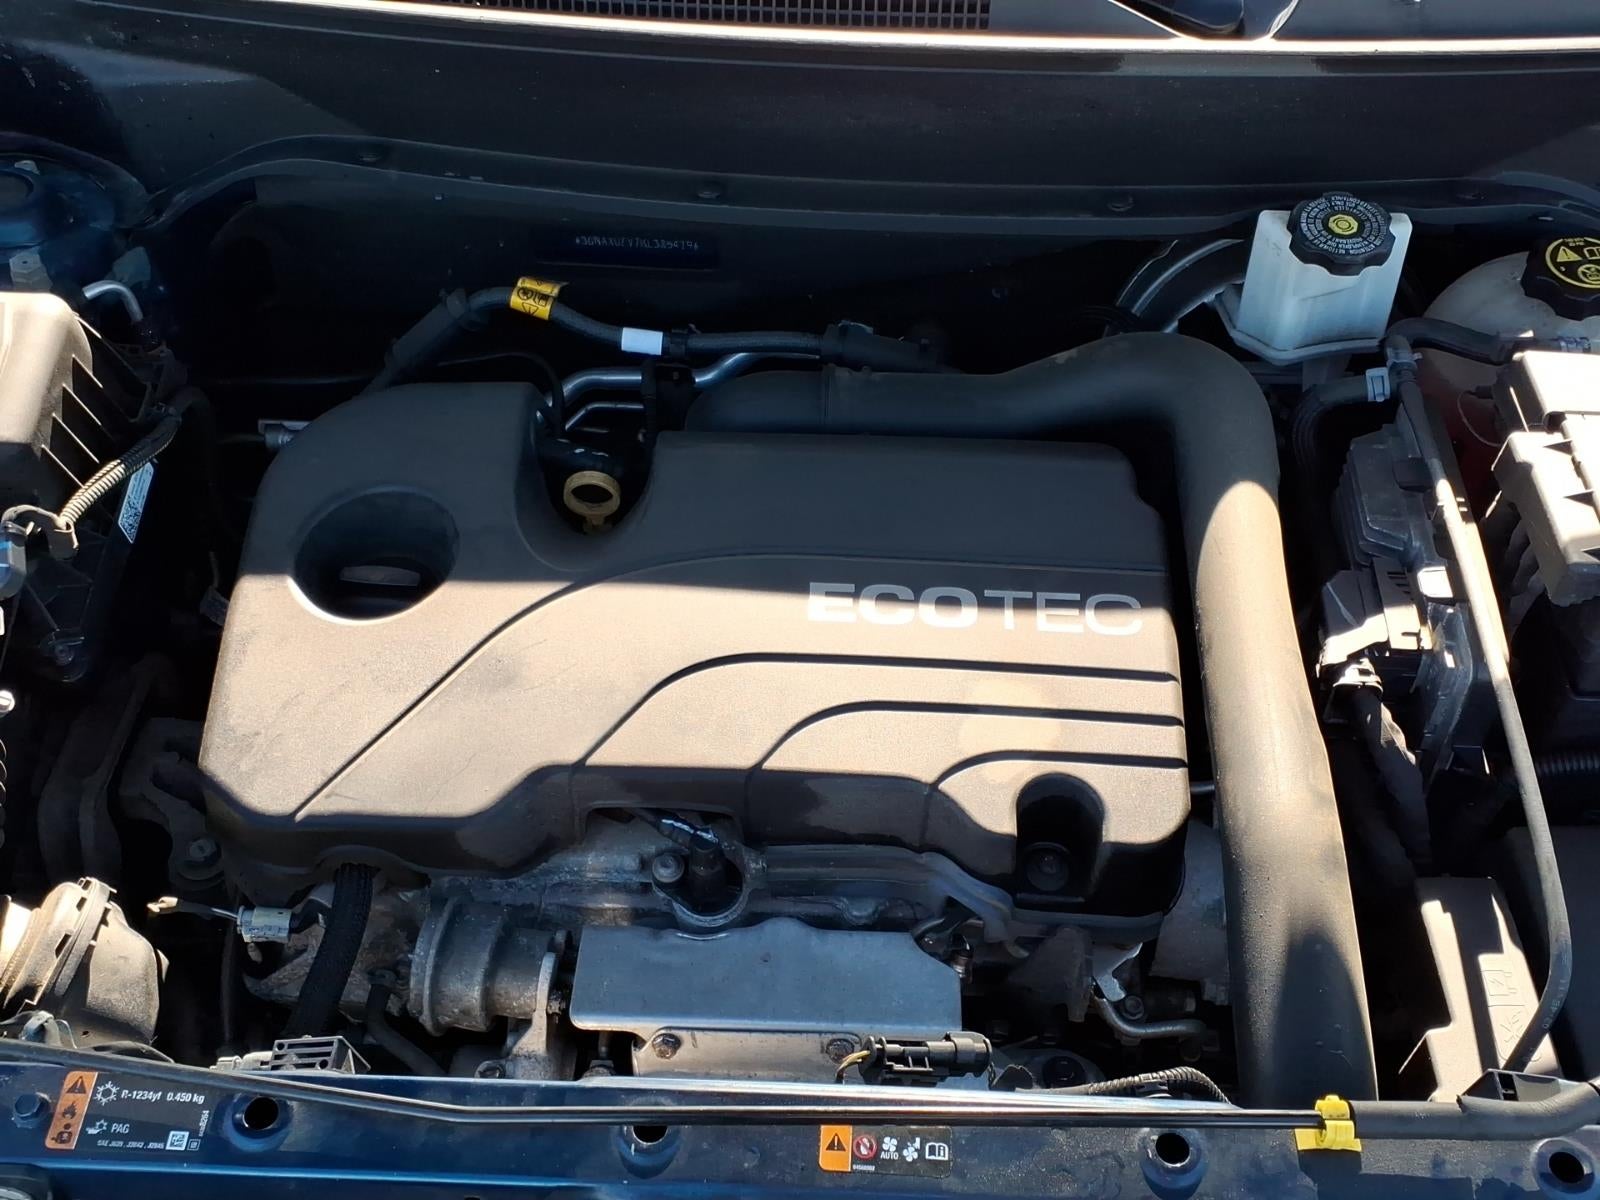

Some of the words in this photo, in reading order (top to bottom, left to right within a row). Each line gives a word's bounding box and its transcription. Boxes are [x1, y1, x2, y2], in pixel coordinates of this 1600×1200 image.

[807, 582, 1143, 636] ECOTEC
[120, 1089, 162, 1103] R-1234yf
[166, 1091, 191, 1103] 0.450
[192, 1092, 205, 1105] kg
[110, 1123, 130, 1135] PAG
[880, 1151, 899, 1160] AUTO
